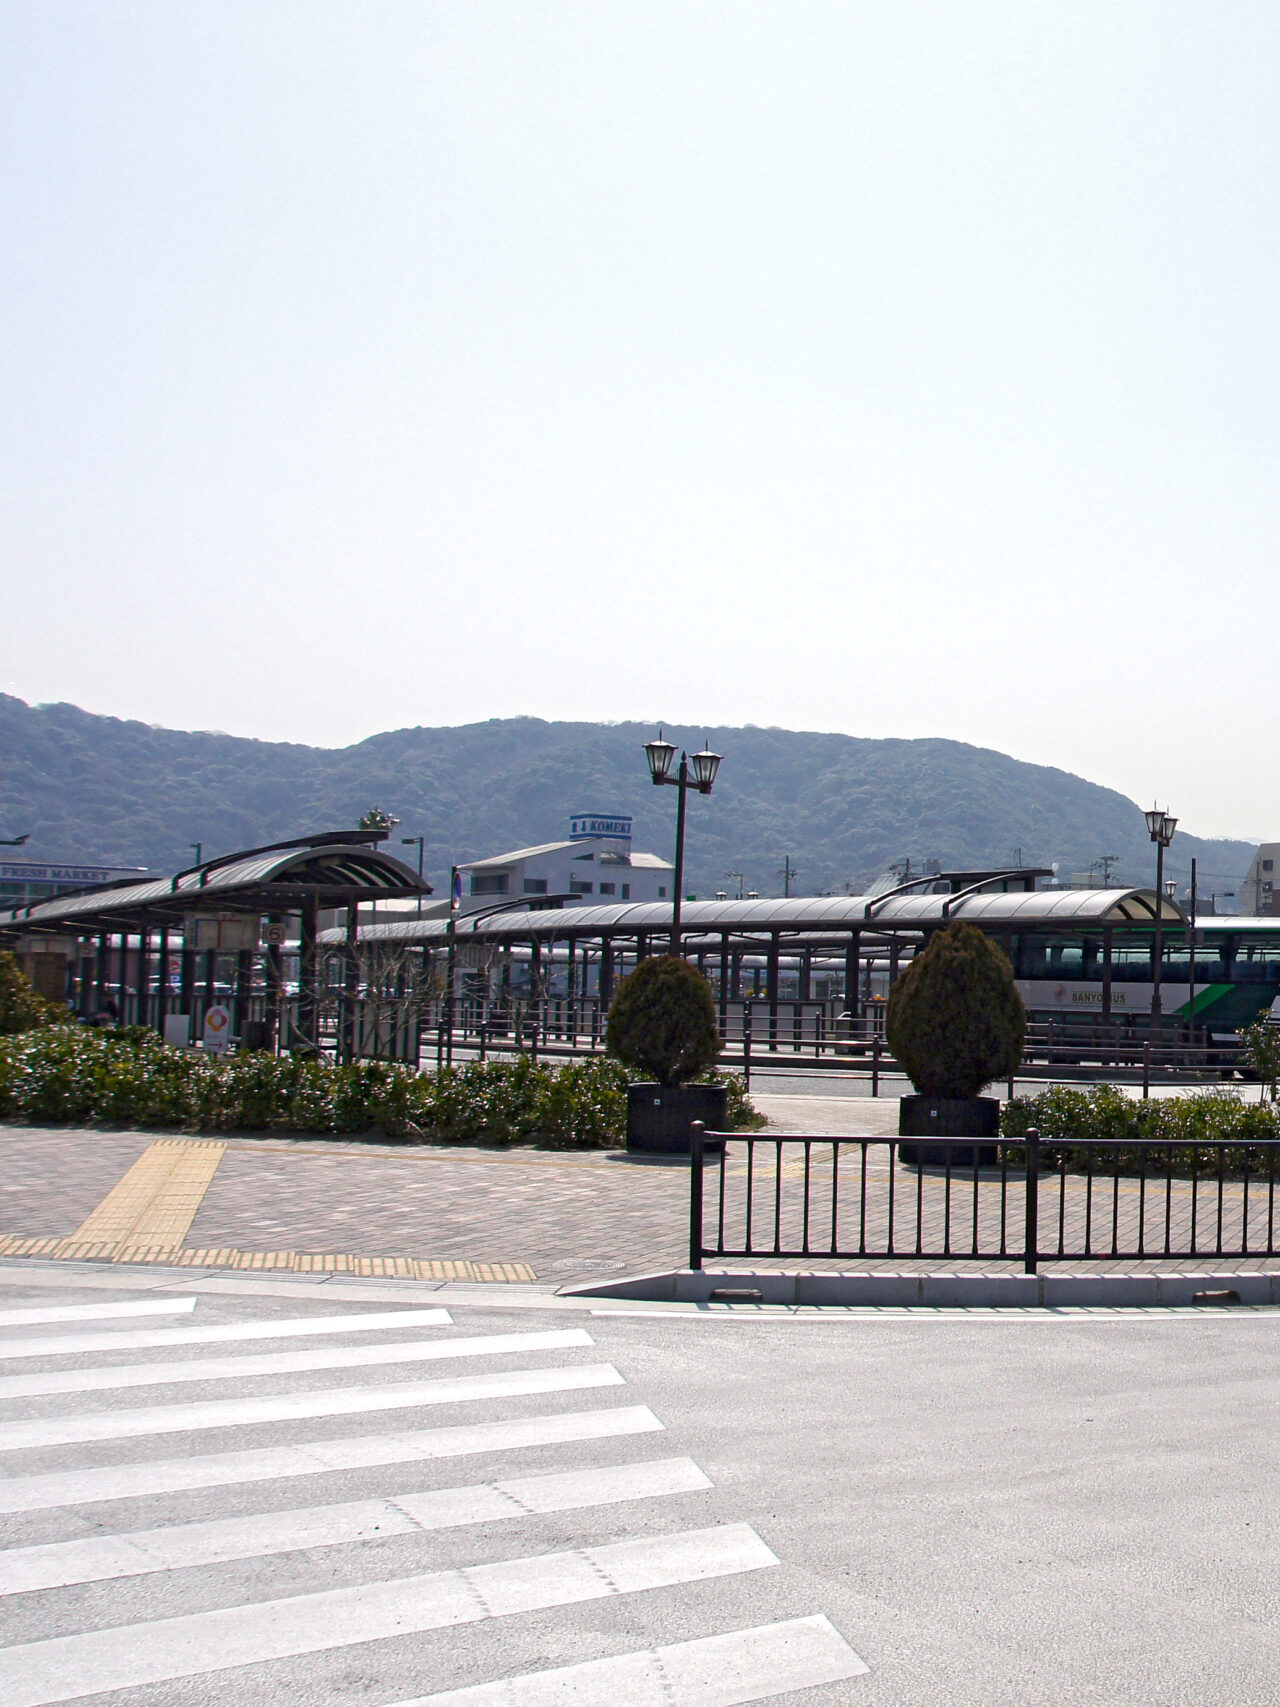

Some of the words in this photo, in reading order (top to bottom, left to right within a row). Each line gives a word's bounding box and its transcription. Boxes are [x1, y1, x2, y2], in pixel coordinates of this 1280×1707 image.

[1, 867, 48, 879] FRESH
[51, 869, 110, 881] MARKET
[1072, 992, 1104, 1003] SANYO
[1109, 993, 1127, 1004] US
